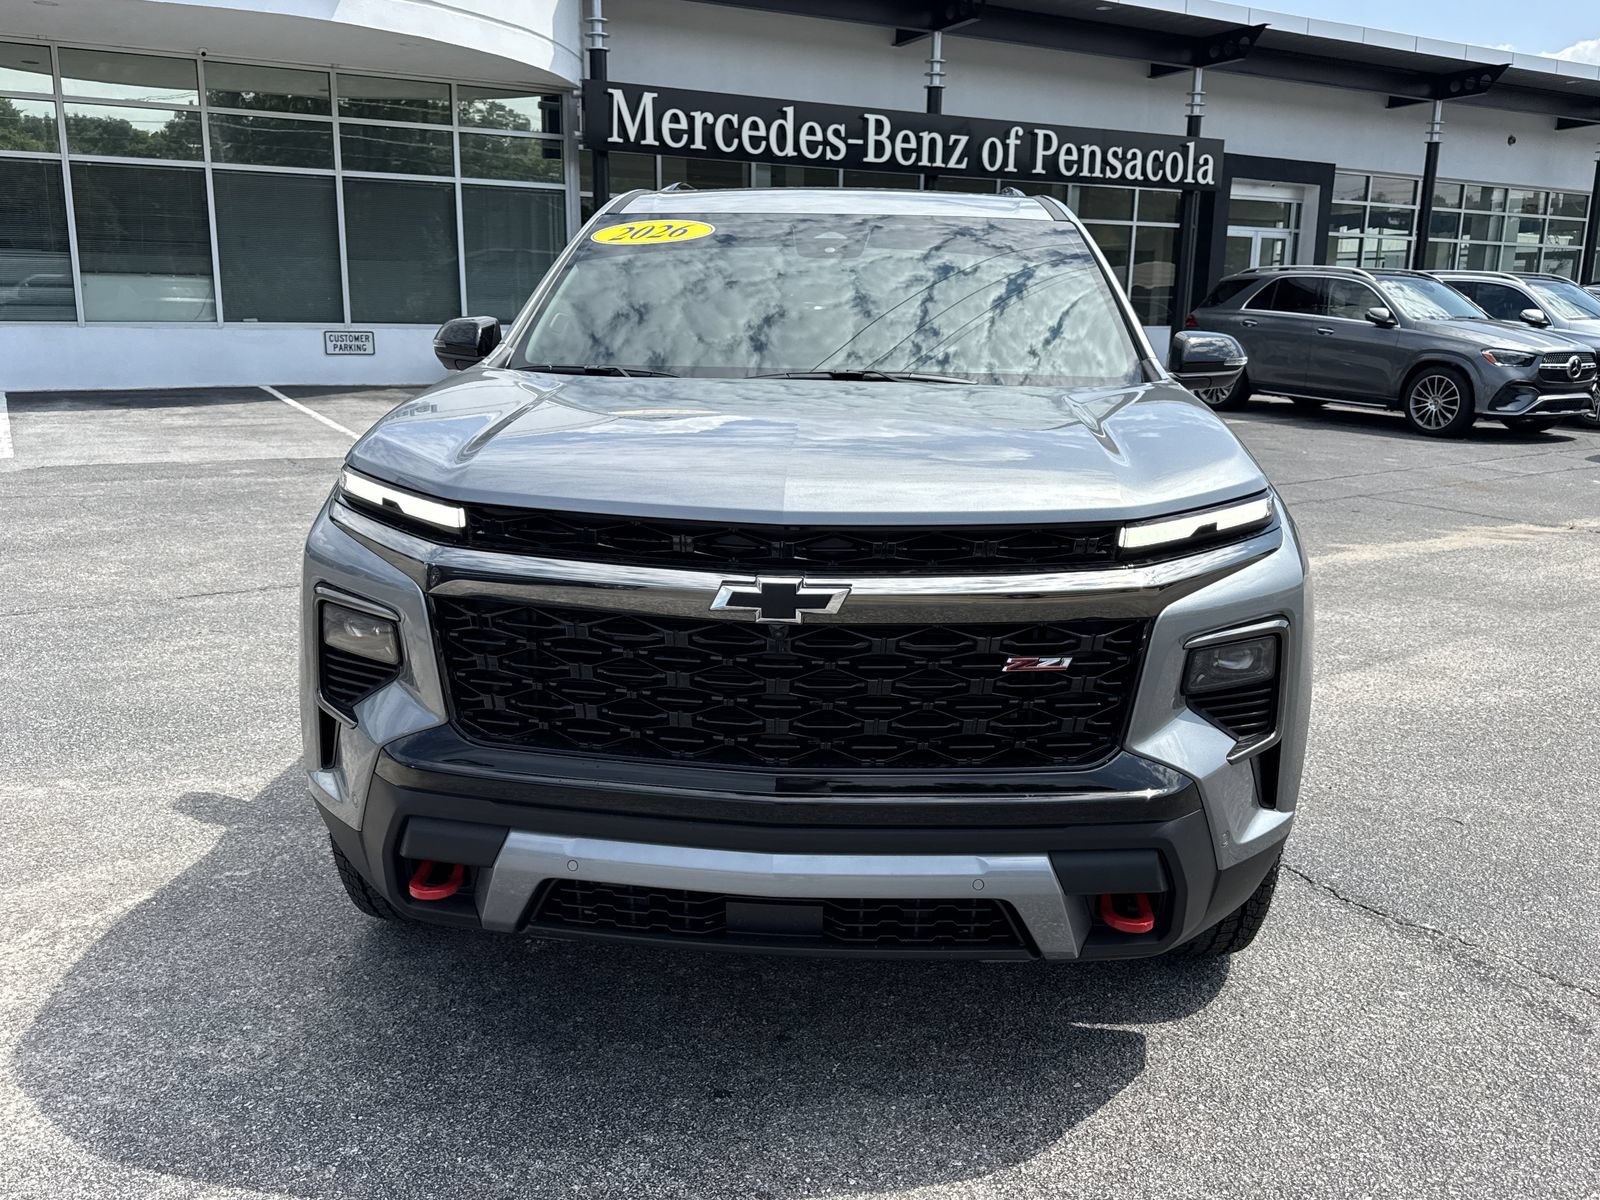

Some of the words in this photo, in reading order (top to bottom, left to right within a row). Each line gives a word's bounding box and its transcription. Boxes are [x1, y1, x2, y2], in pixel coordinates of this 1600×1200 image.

[607, 88, 970, 170] Mercedes-Benz
[981, 126, 1023, 173] of
[1032, 128, 1215, 185] Pensacola
[608, 224, 696, 242] 2026
[328, 334, 370, 343] CUSTOMER
[333, 343, 367, 352] PARKING
